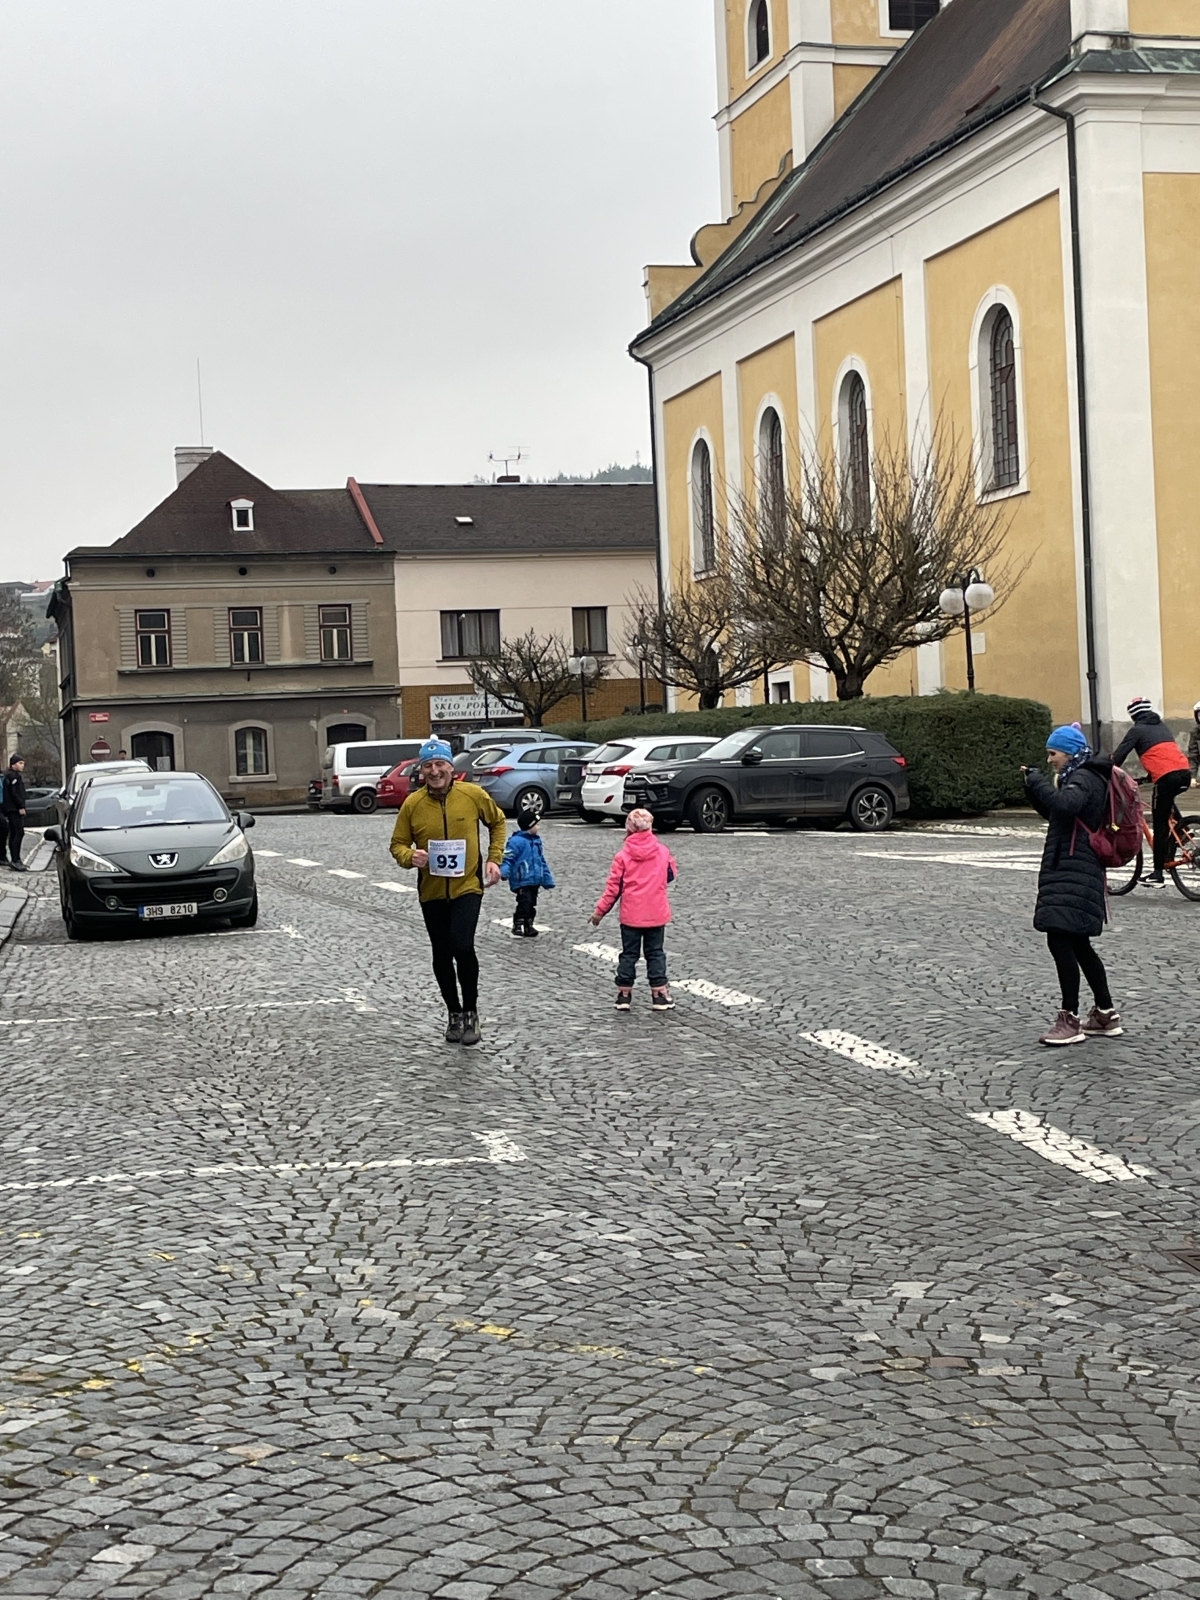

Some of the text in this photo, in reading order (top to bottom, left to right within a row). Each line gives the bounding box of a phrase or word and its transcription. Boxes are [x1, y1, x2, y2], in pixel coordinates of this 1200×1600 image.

[434, 702, 460, 710] SKLO
[437, 854, 458, 869] 93
[146, 904, 193, 916] 3H9 8210
